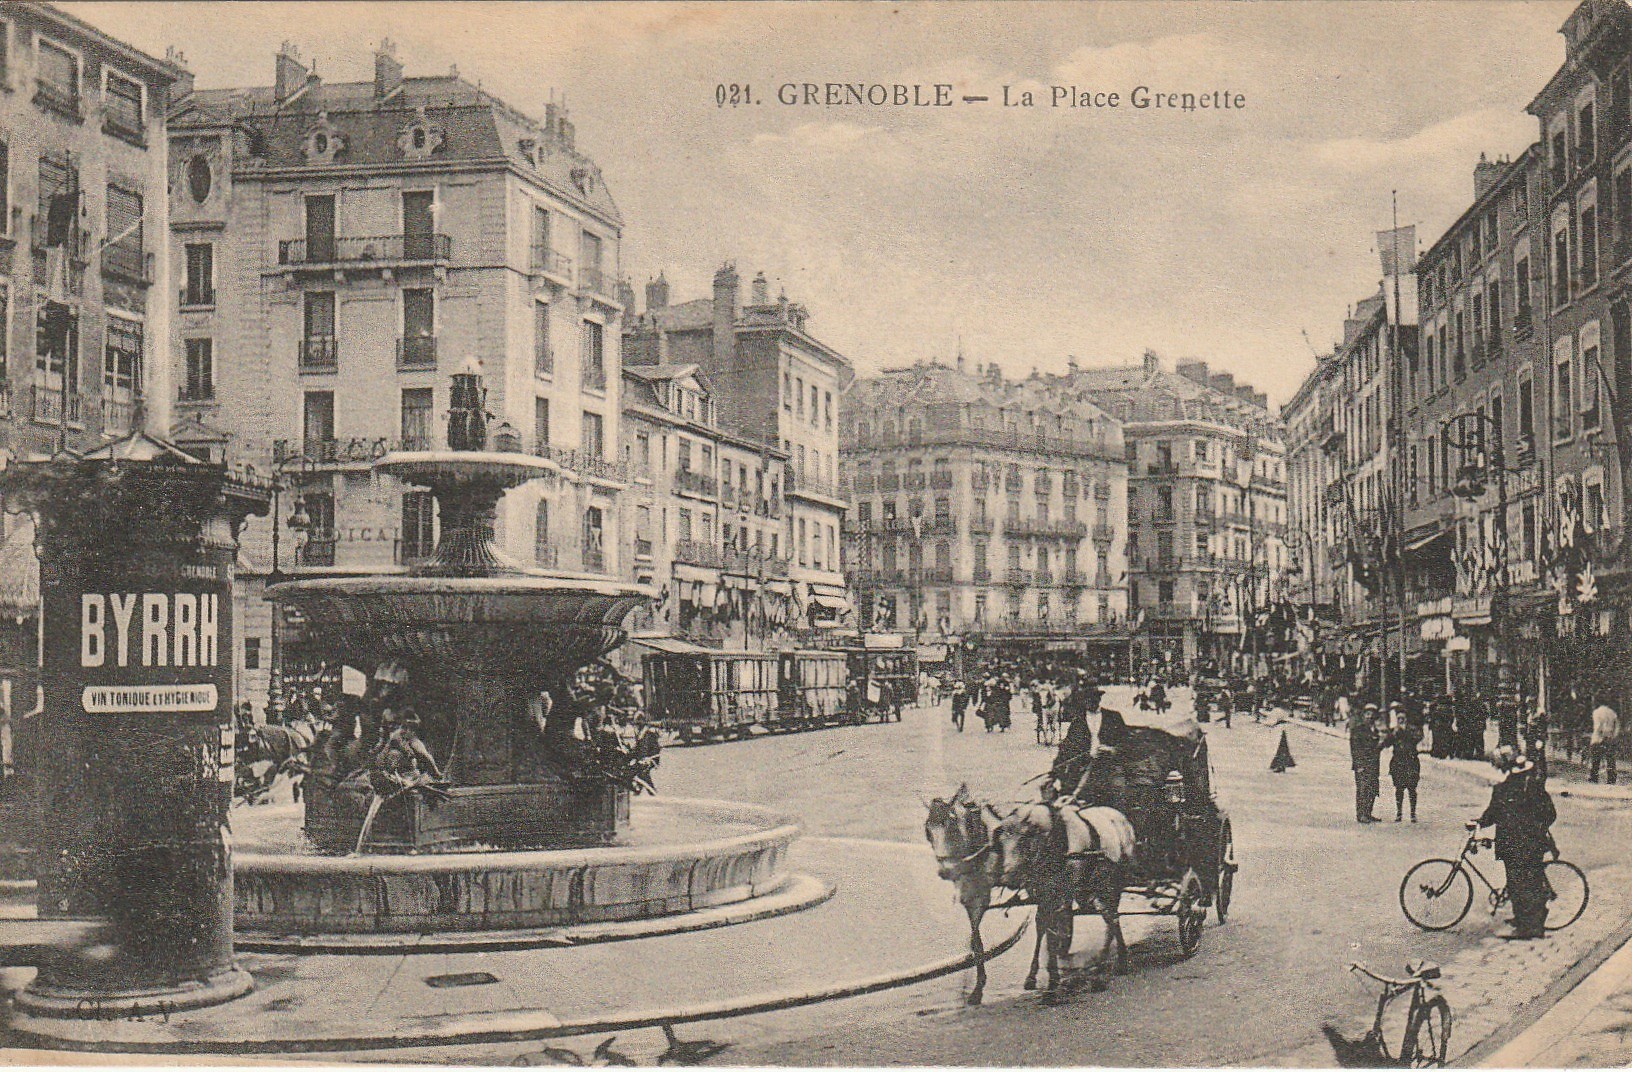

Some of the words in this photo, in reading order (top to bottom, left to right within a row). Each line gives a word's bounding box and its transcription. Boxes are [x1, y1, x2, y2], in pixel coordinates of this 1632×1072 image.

[81, 593, 218, 667] BYRRH
[91, 691, 107, 706] VIN
[110, 691, 151, 706] TONIQUE
